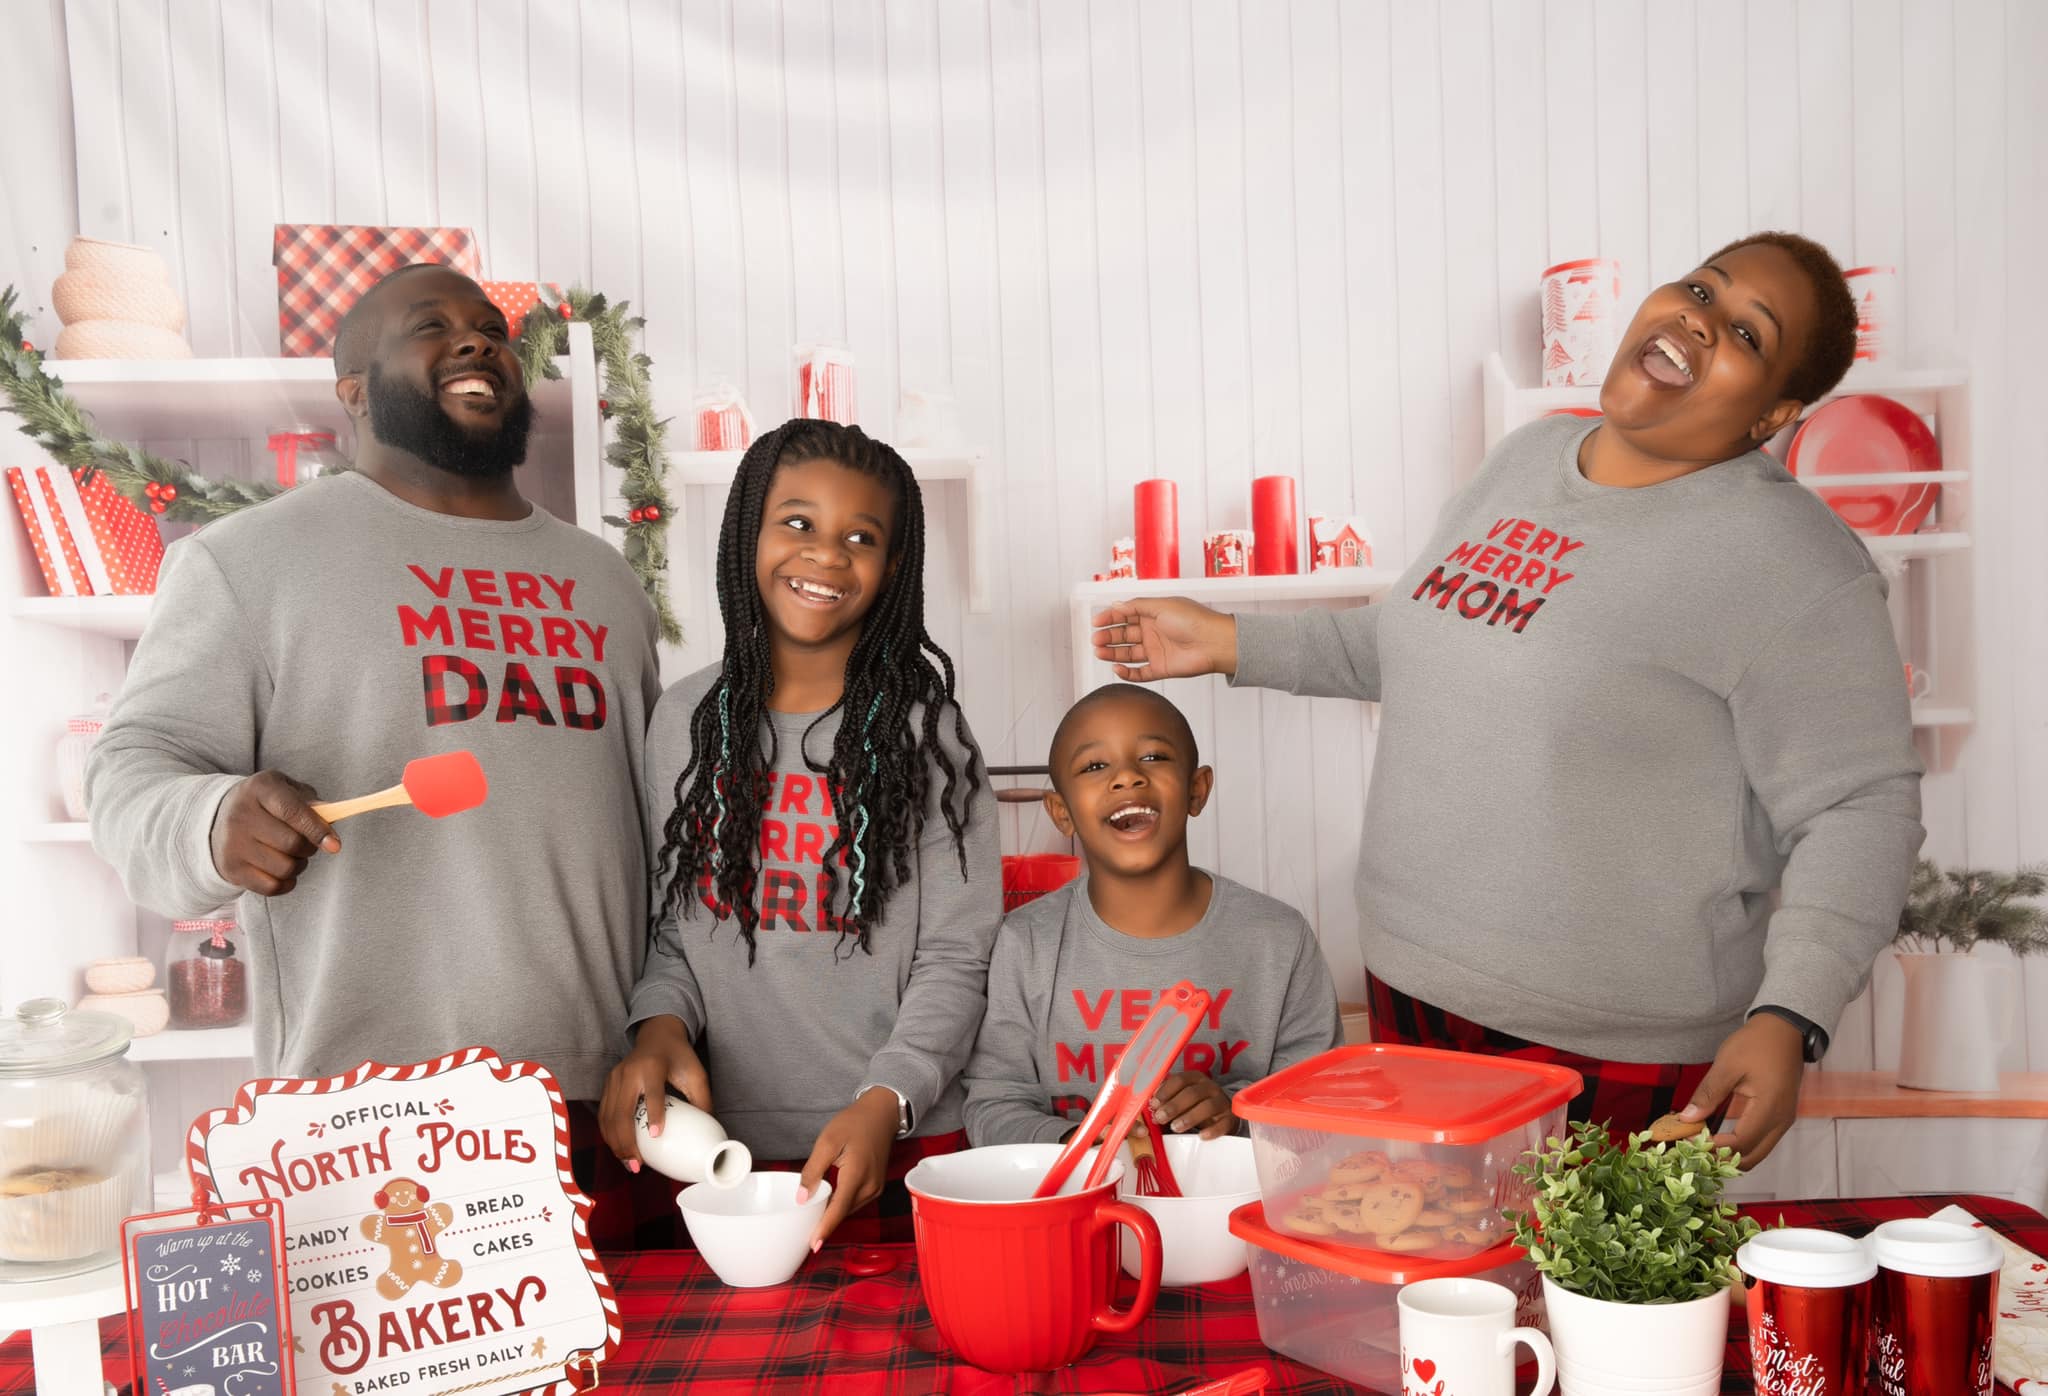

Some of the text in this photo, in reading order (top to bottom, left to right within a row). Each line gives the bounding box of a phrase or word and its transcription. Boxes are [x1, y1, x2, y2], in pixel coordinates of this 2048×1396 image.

[1486, 517, 1585, 562] VERY
[406, 564, 576, 612] VERY
[1444, 541, 1575, 594] MERRY
[1411, 565, 1547, 634] MOM
[396, 604, 609, 662] MERRY
[421, 654, 608, 731] DAD
[1071, 988, 1233, 1031] VEY
[1055, 1040, 1249, 1084] MERY
[331, 1101, 430, 1130] OFFICIAL
[238, 1121, 536, 1218] NORTH POLE
[466, 1194, 525, 1217] BREAD
[155, 1230, 254, 1258] Warm up at the
[286, 1226, 349, 1251] CANDY
[472, 1233, 534, 1257] CAKES
[157, 1277, 212, 1313] HOT
[159, 1290, 271, 1349] Chocolate
[311, 1275, 547, 1376] BAKERY
[212, 1341, 266, 1369] BAR
[355, 1345, 524, 1395] BAKED FRESH DAILY
[1764, 1344, 1819, 1378] Most
